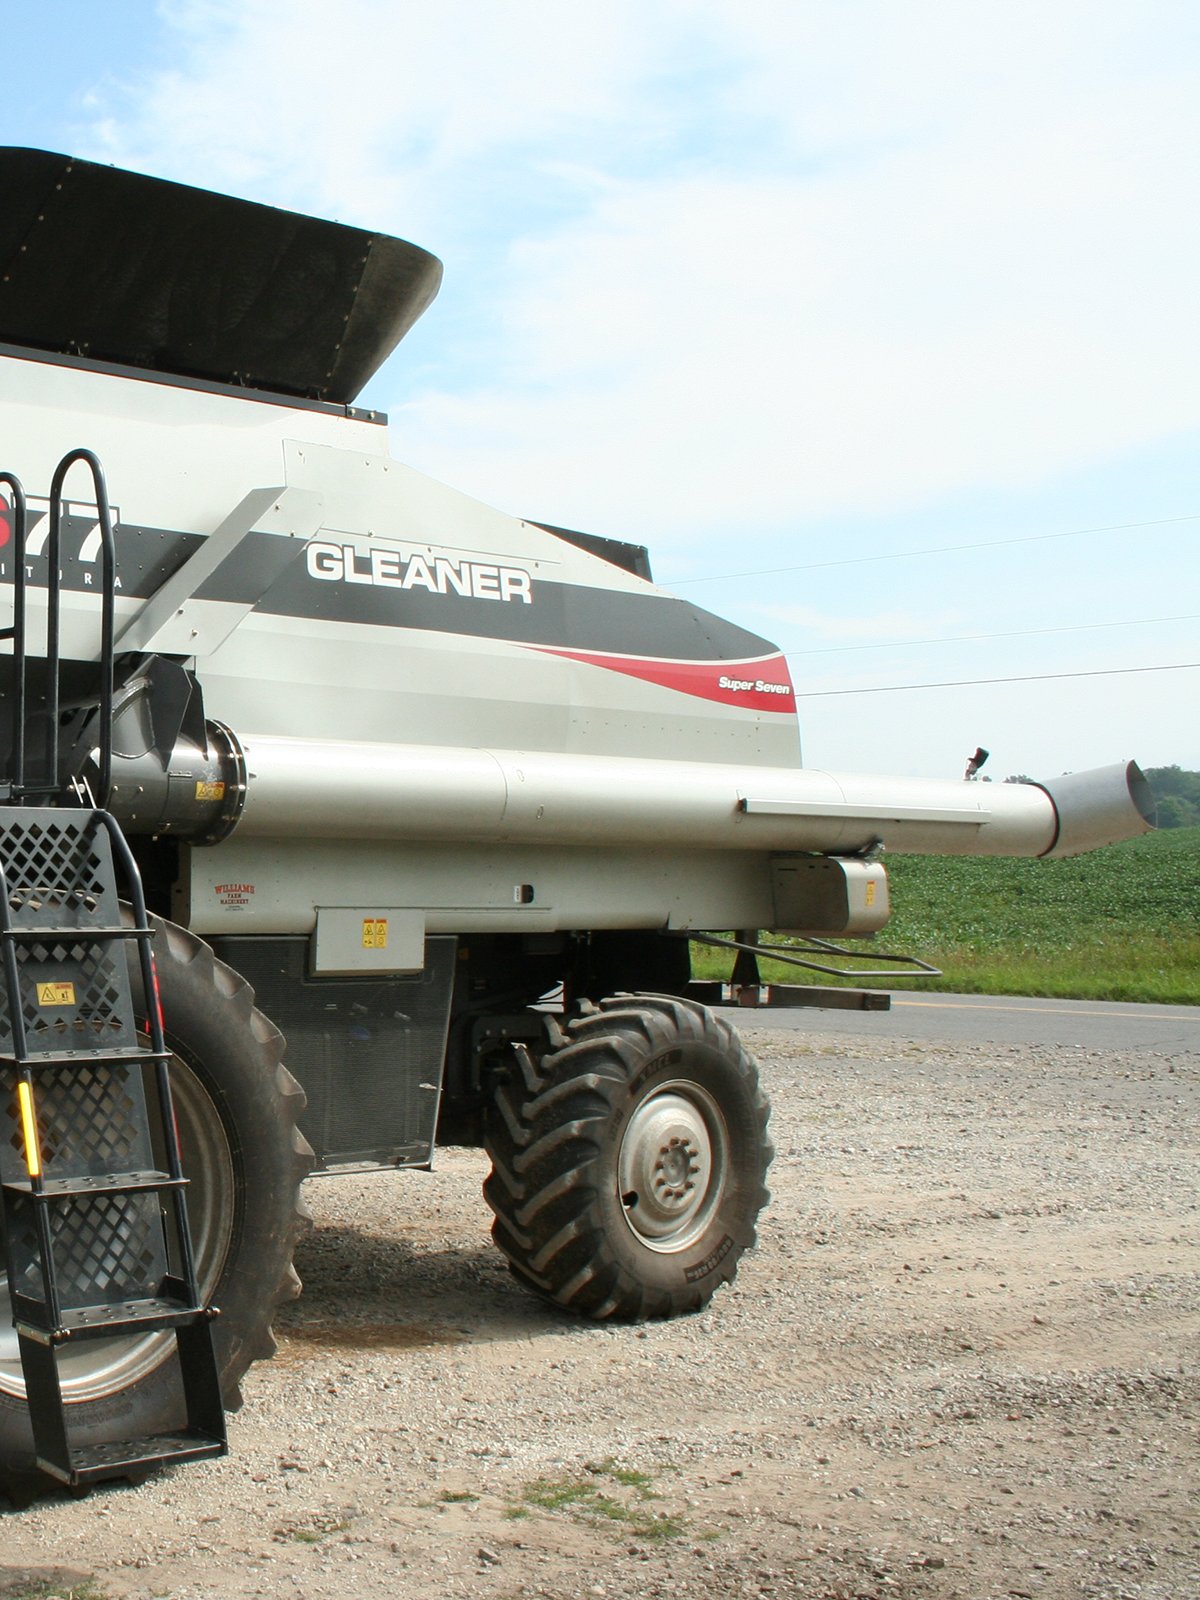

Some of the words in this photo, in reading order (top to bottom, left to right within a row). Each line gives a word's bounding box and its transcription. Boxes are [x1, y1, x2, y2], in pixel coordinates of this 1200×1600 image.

[306, 542, 532, 604] GLEANER
[719, 676, 754, 692] Super
[755, 680, 790, 695] Seven
[214, 884, 255, 894] WILLIAMS
